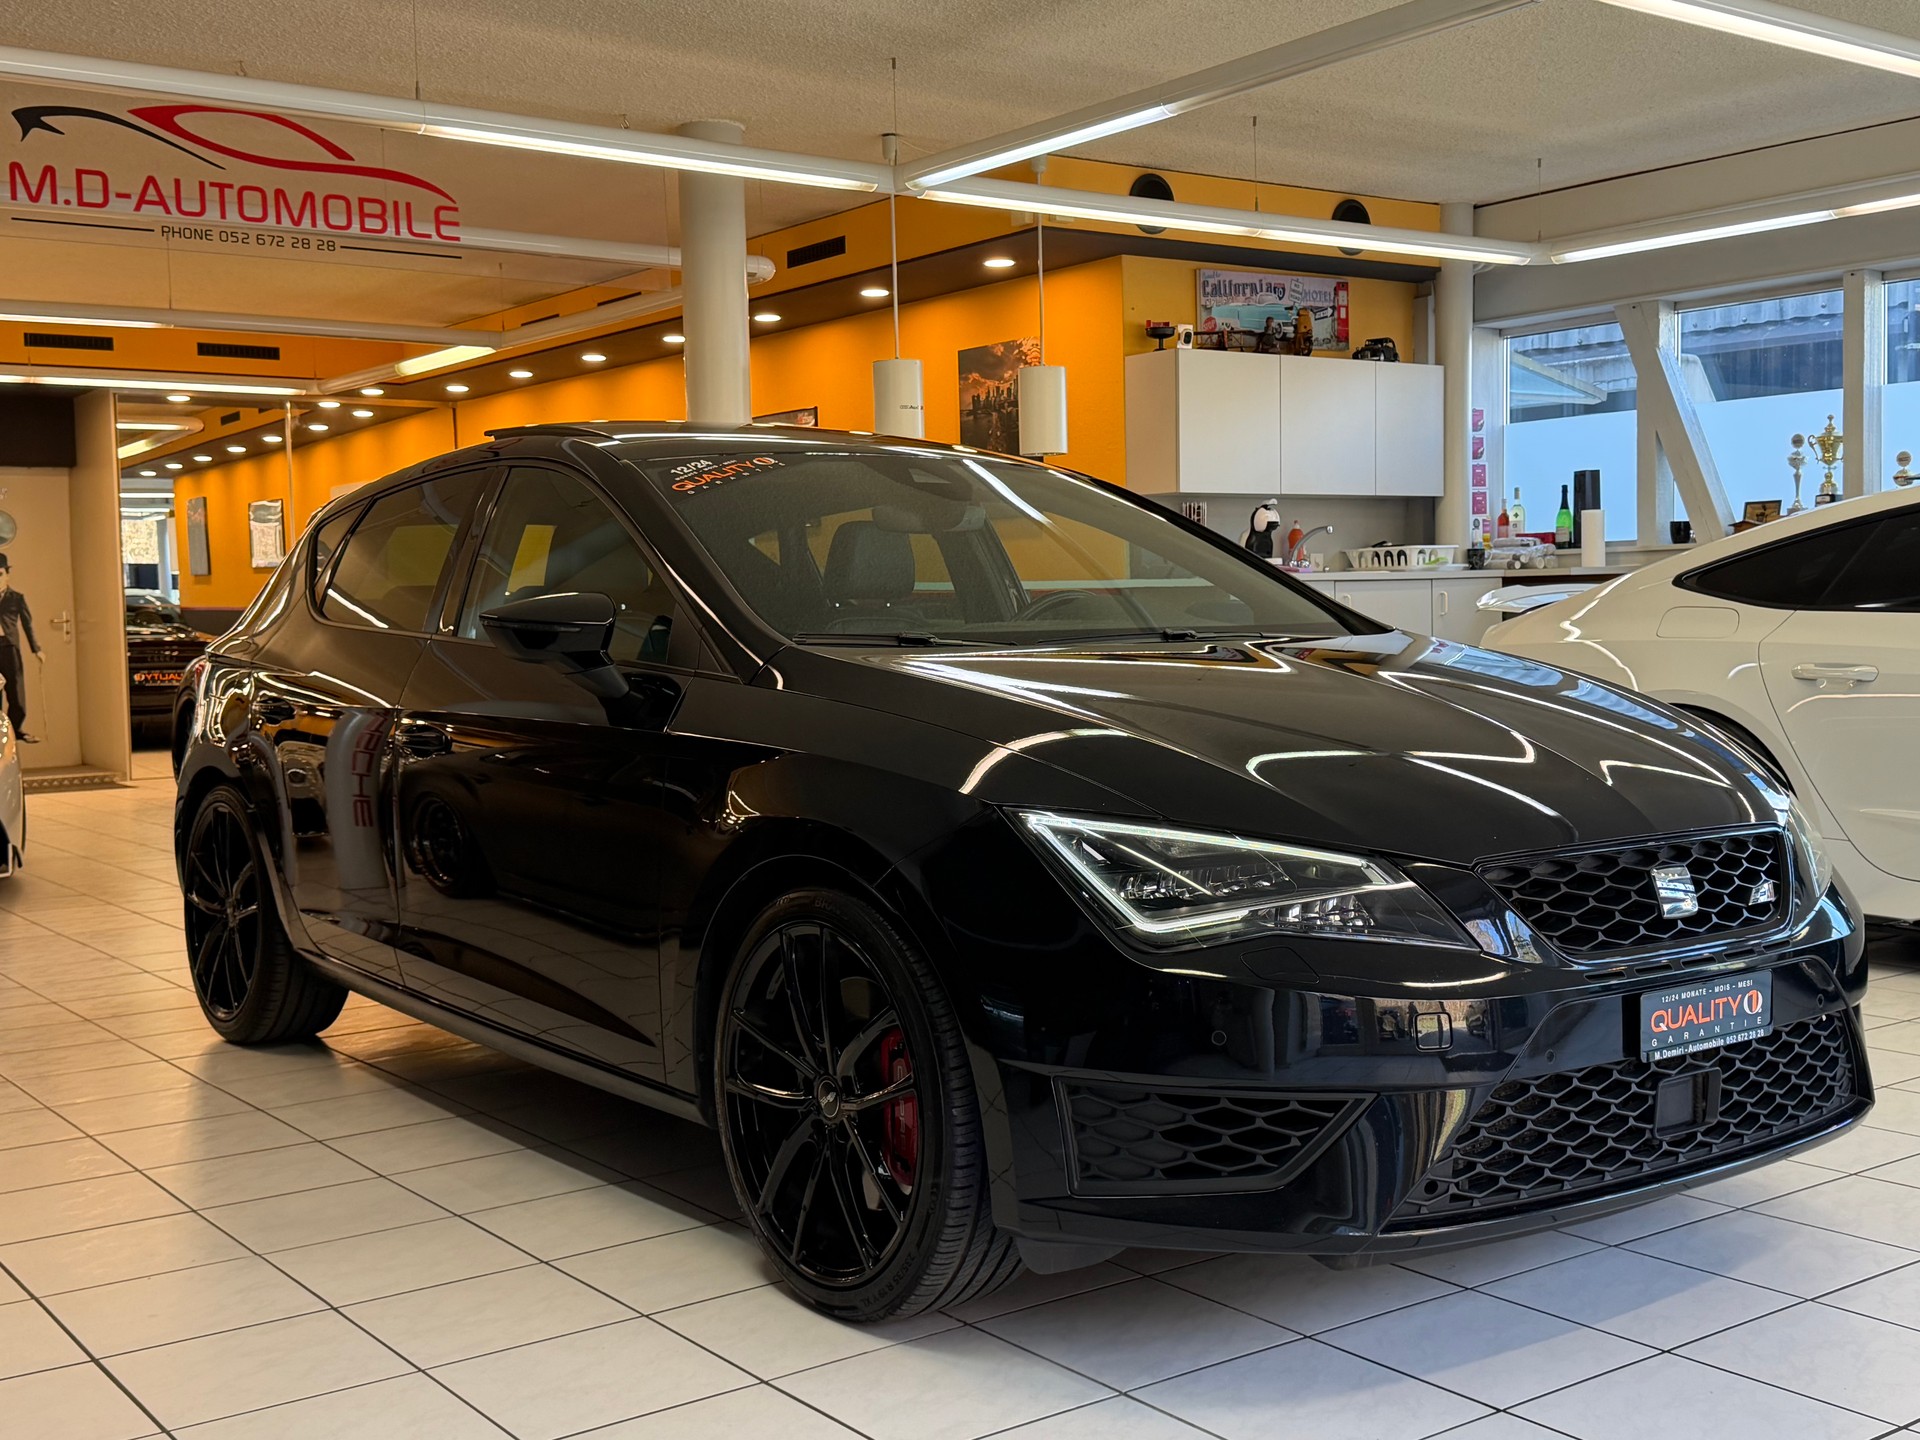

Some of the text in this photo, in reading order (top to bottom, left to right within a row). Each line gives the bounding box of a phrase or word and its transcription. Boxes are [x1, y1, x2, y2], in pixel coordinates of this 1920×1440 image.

[8, 161, 462, 242] M.D-AUTOMOBILE
[161, 225, 336, 252] PHONE 052 672 28 28
[1202, 279, 1274, 298] California
[671, 459, 713, 475] 12/24
[672, 460, 755, 491] QUALITY
[1661, 992, 1679, 1003] 12/24
[1681, 988, 1707, 999] MONATE
[1714, 984, 1730, 993] MOIS
[1737, 979, 1753, 989] MESI
[1651, 994, 1742, 1033] QUALITY
[1652, 1016, 1762, 1047] GARANTIE
